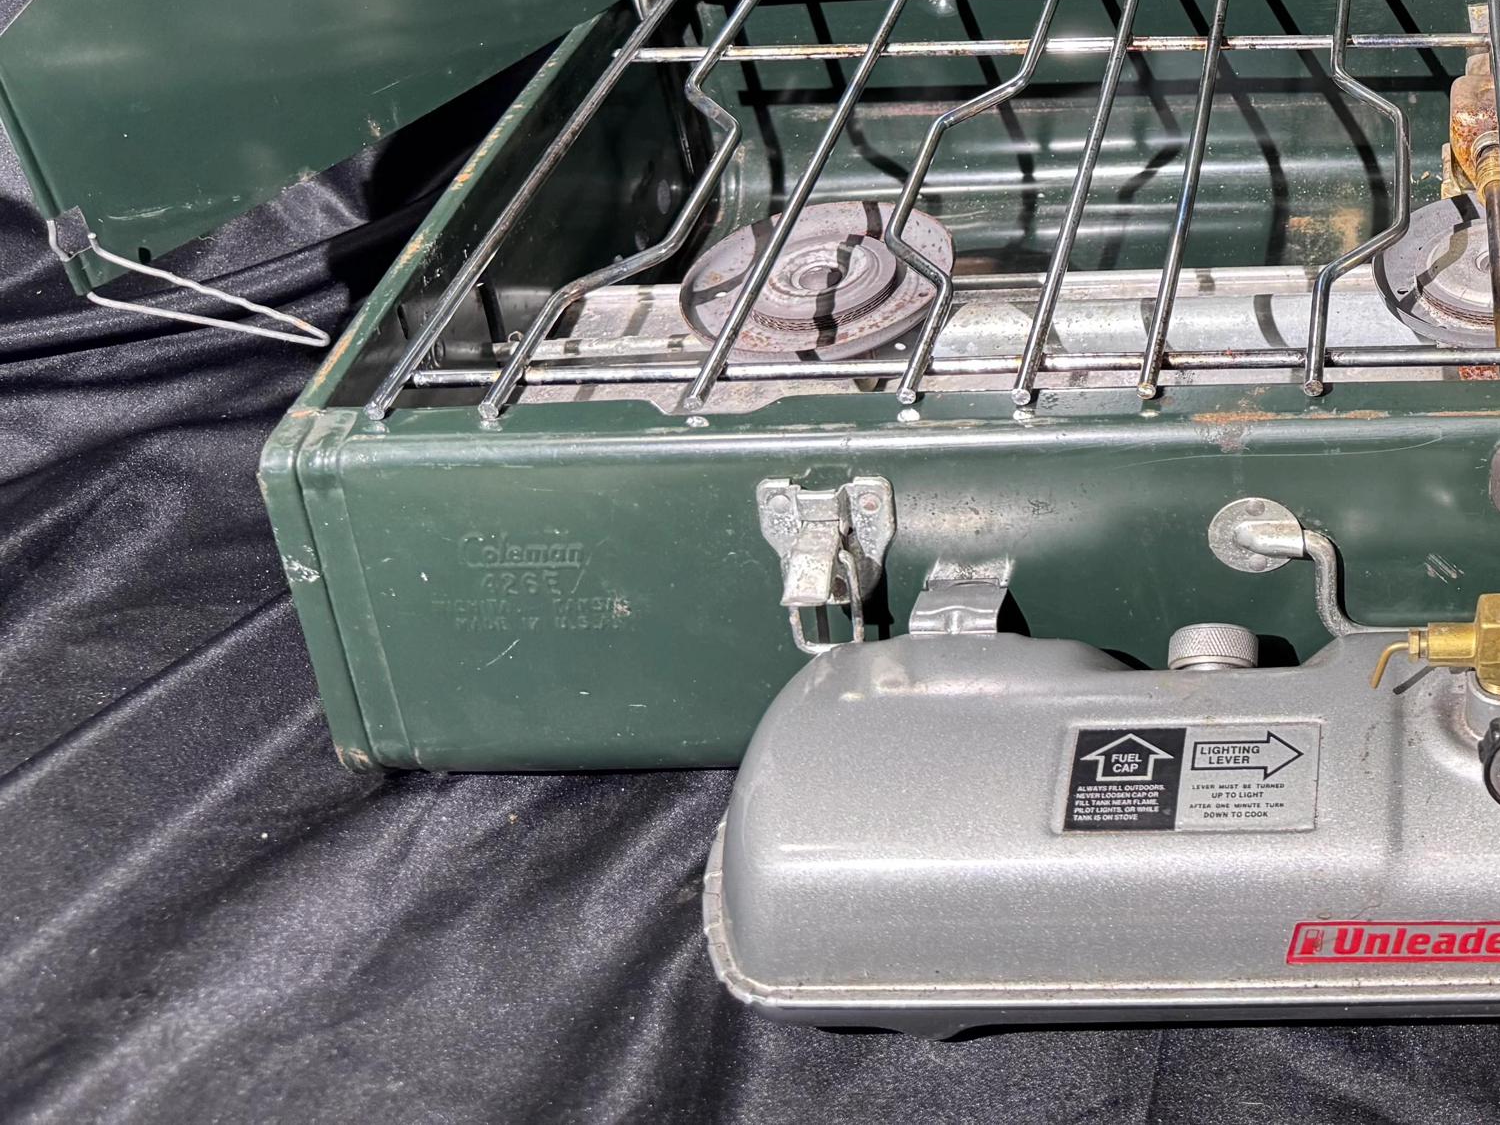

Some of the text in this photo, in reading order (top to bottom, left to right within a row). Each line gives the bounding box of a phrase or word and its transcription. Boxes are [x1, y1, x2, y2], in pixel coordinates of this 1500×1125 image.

[1200, 745, 1260, 755] LIGHTING
[1111, 753, 1142, 763] FUEL
[1208, 755, 1250, 764] LEVER
[1112, 763, 1139, 773] CAP
